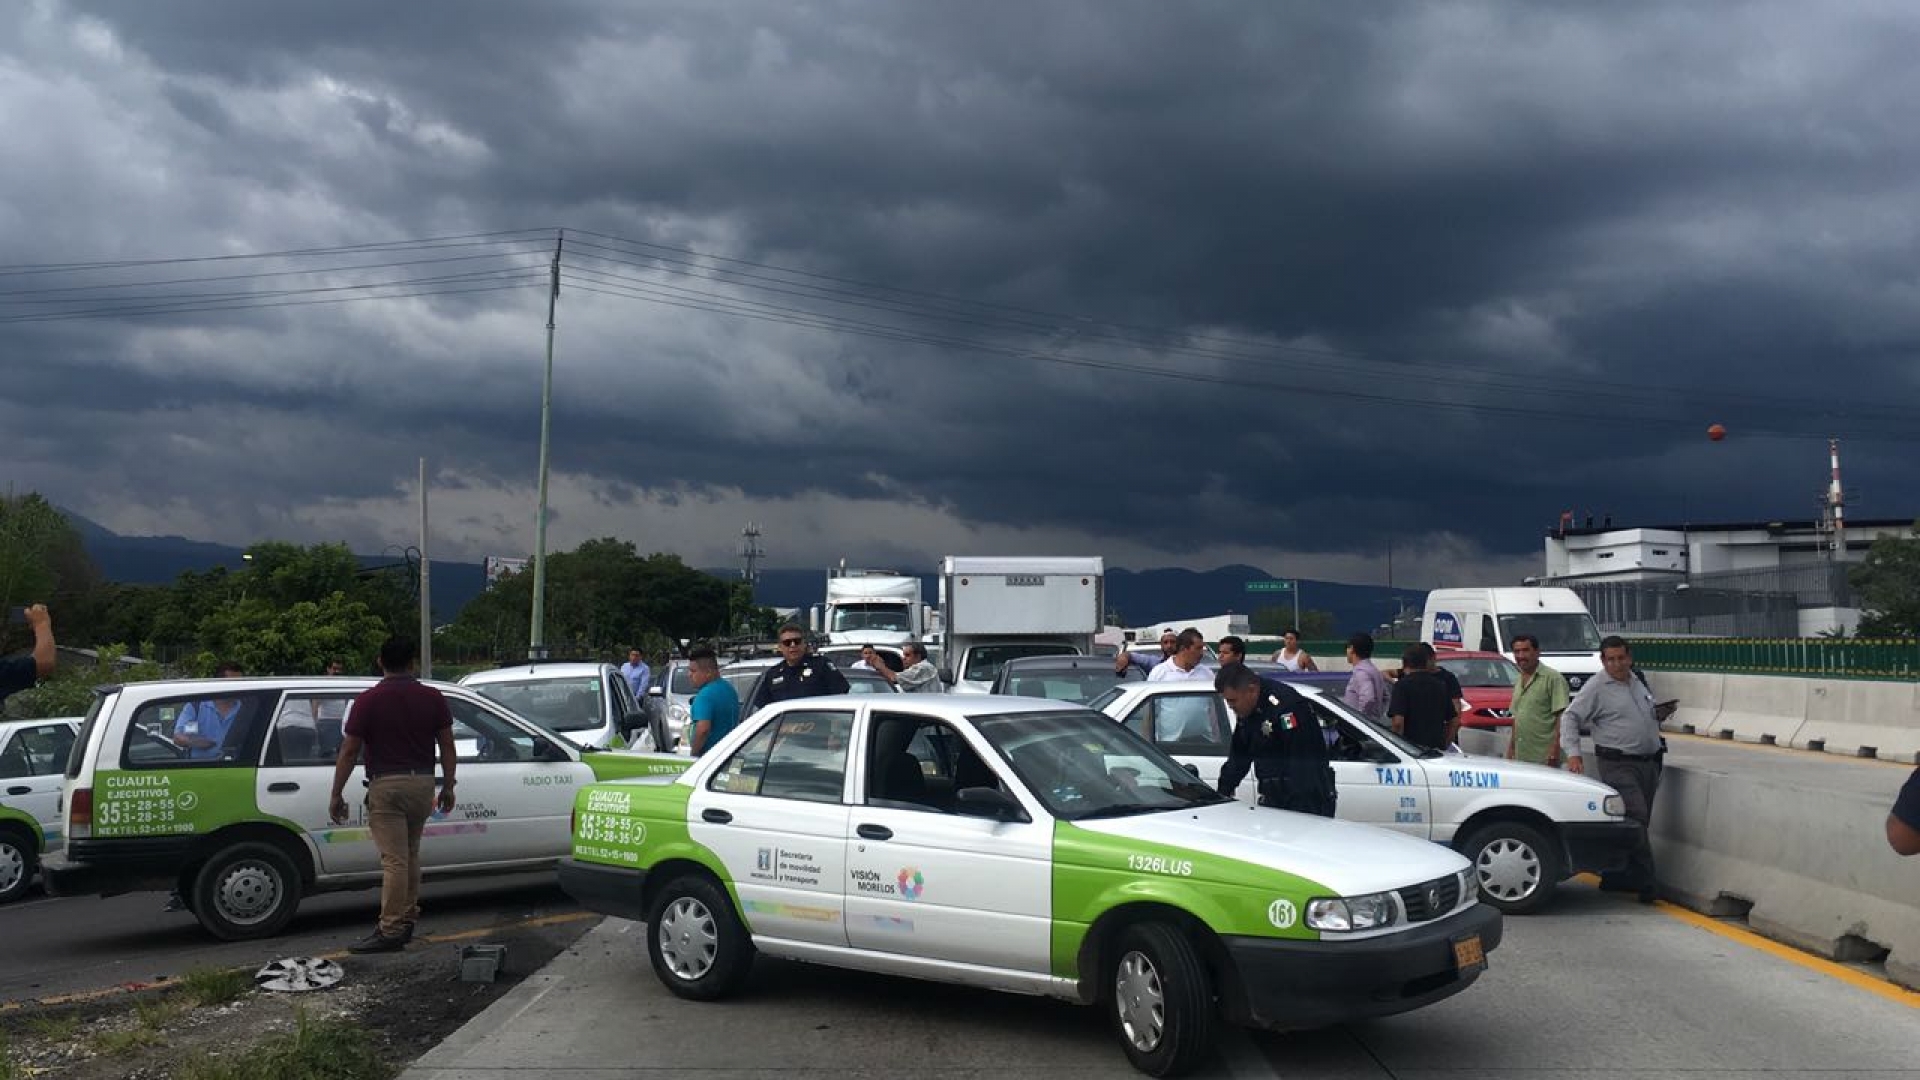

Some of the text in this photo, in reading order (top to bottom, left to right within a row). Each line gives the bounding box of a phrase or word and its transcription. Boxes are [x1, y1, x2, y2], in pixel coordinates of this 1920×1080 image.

[107, 776, 170, 787] CUAUTLA
[523, 776, 551, 786] RADIO
[1376, 767, 1412, 784] TAXI
[1449, 770, 1500, 788] 1015 LVM
[107, 789, 169, 799] EJECUTIVOS
[589, 790, 631, 804] CUAUTLA
[99, 801, 121, 825] 35
[587, 801, 630, 814] EJECUTIVOS
[1588, 801, 1597, 811] 6
[579, 813, 594, 840] 35
[780, 862, 788, 870] de
[1128, 855, 1192, 876] 1326LUS
[857, 881, 895, 895] MORELOS
[1271, 903, 1293, 925] 161
